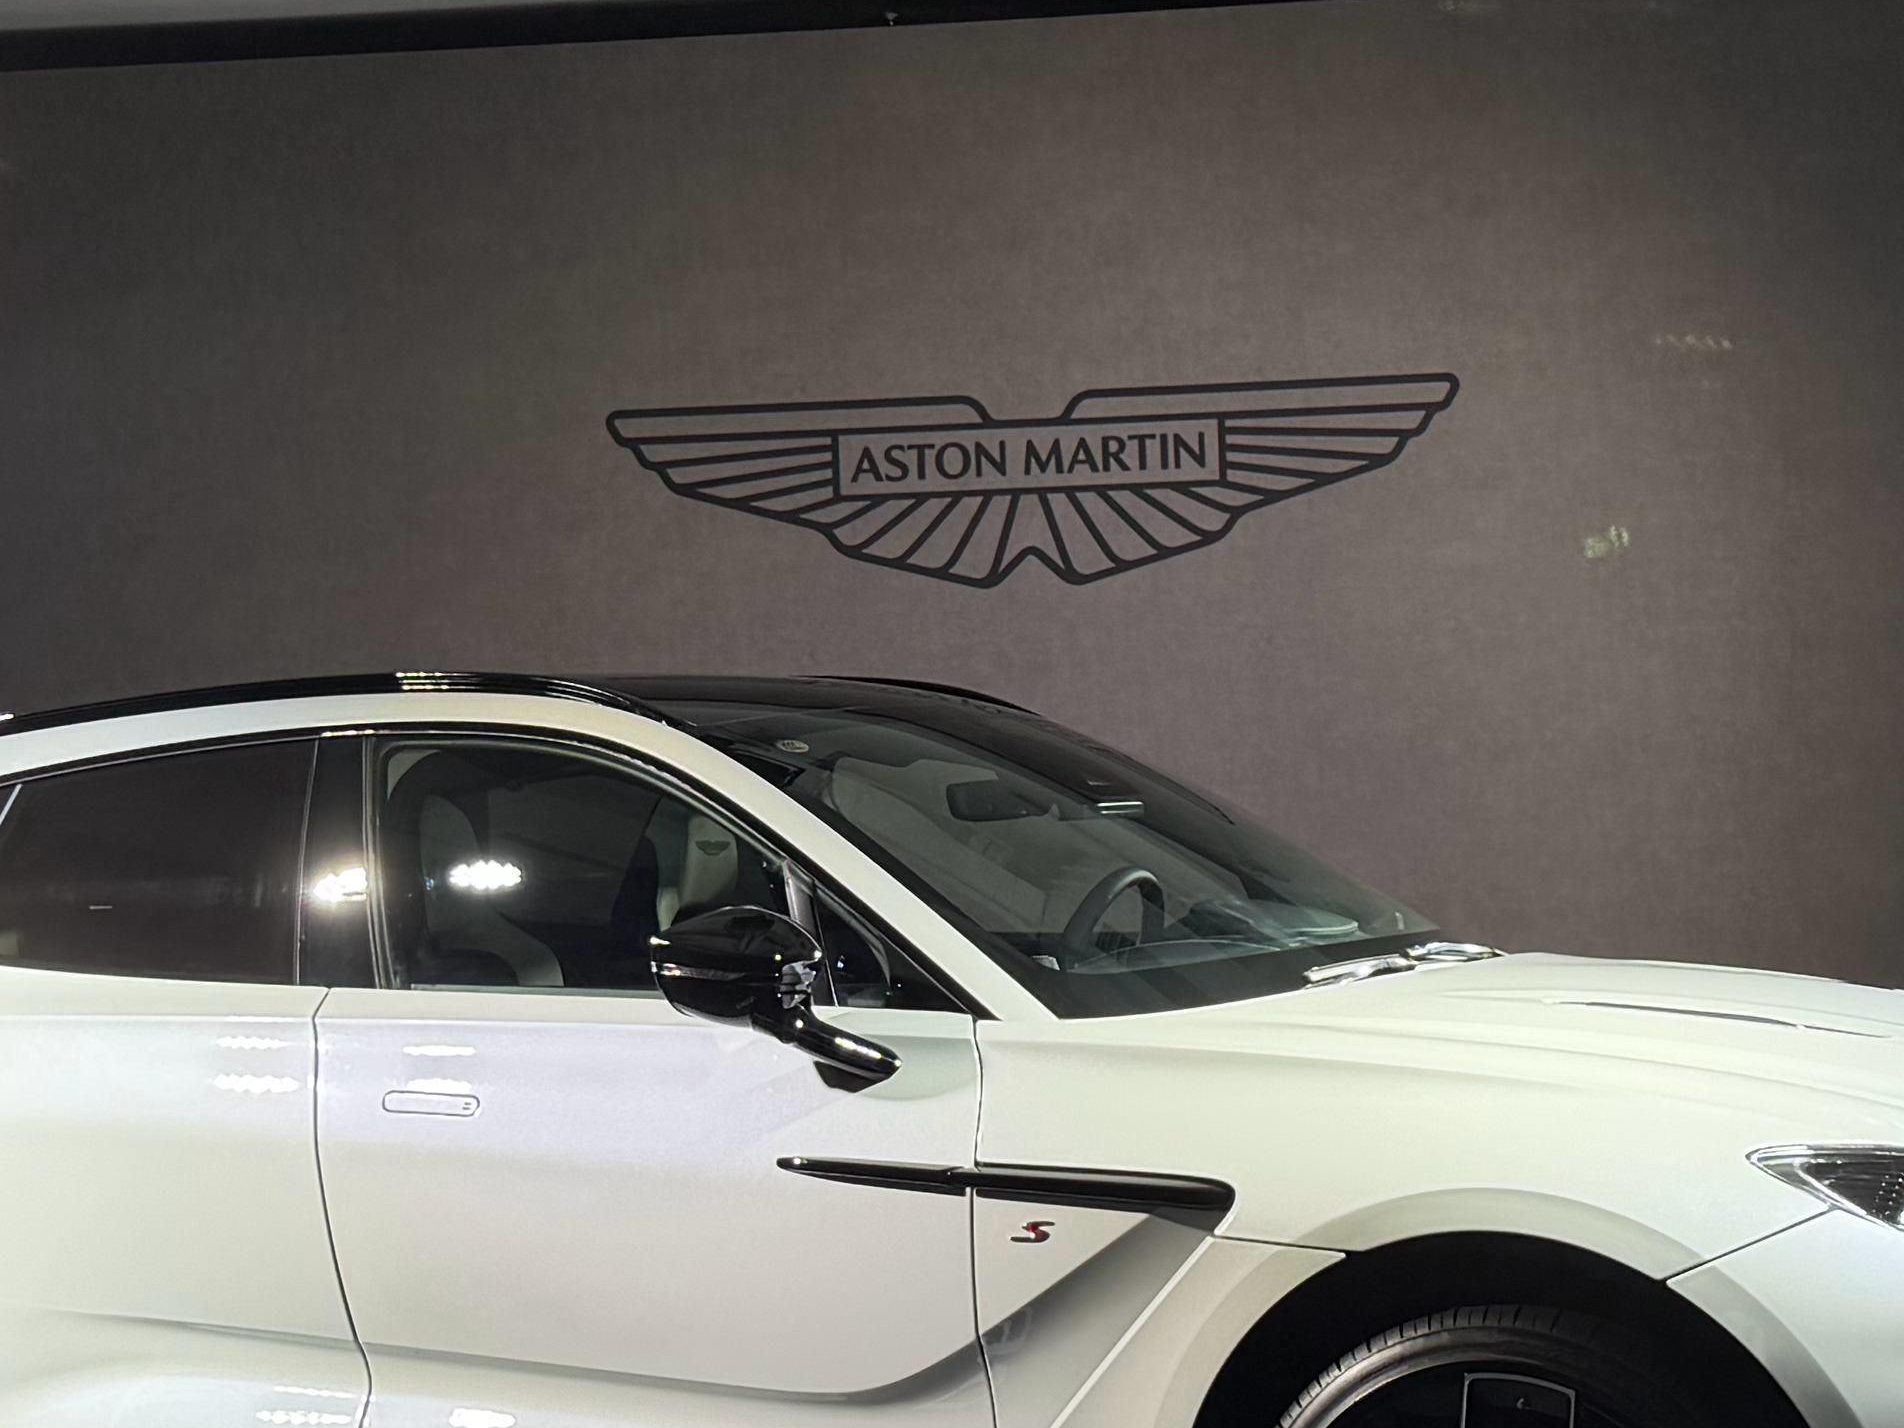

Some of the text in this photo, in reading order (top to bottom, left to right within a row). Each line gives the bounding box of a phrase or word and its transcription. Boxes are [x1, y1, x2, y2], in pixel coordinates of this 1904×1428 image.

[850, 431, 1207, 484] ASTON MARTIN
[1009, 1220, 1056, 1243] S
